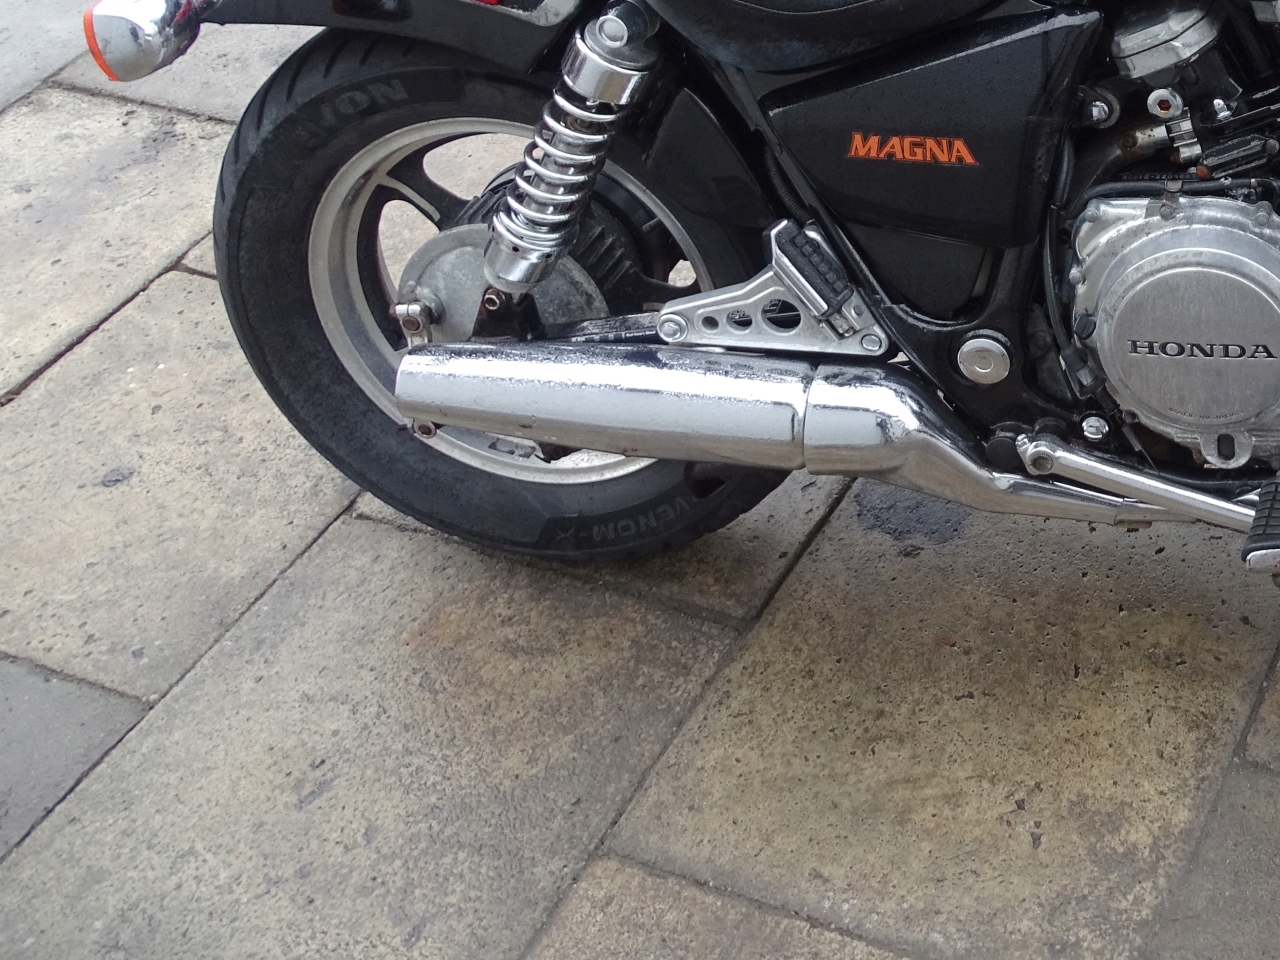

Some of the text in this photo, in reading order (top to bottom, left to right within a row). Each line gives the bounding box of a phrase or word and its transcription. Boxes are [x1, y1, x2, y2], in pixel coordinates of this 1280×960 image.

[847, 131, 980, 166] MAGNA
[1126, 339, 1278, 359] HONDA
[556, 496, 691, 541] VENOM-X
